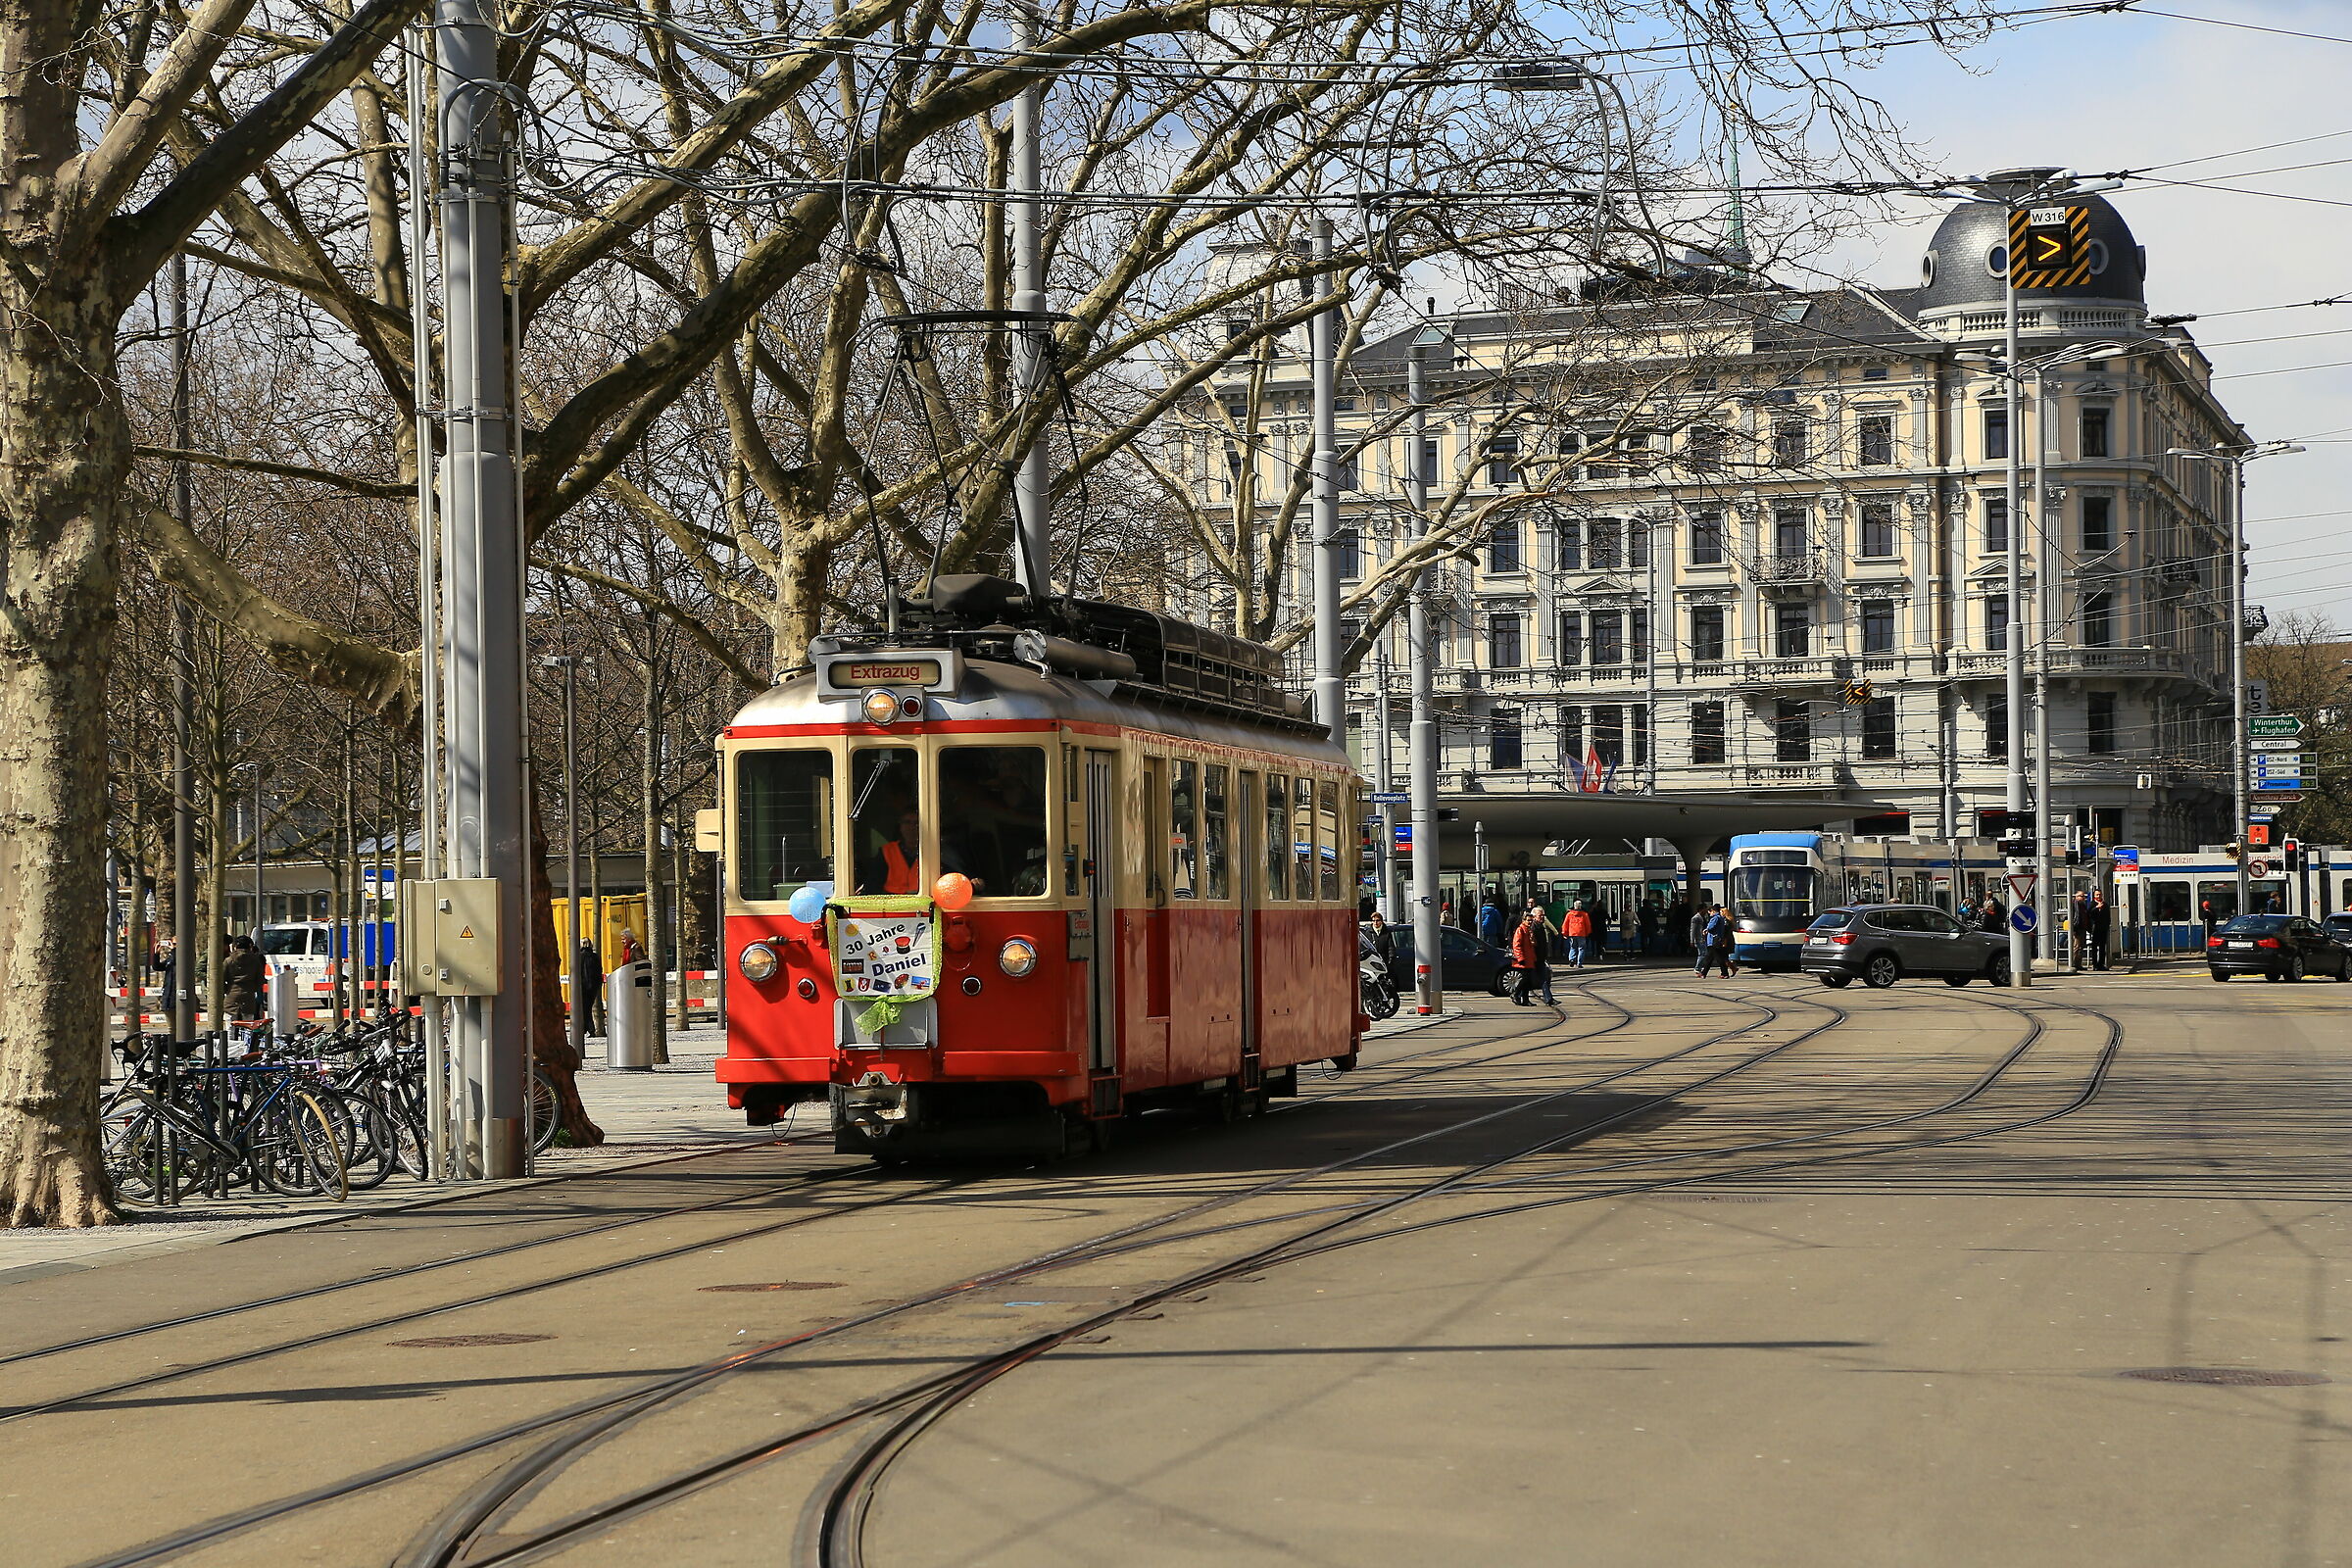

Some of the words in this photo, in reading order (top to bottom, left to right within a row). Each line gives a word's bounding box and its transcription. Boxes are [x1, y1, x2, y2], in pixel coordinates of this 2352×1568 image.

[2032, 213, 2042, 222] W
[2044, 212, 2065, 222] 316
[851, 664, 920, 681] Extrazug
[2261, 726, 2296, 736] Flughafen
[2162, 856, 2194, 864] Medizin
[845, 940, 863, 956] 30
[867, 923, 906, 947] Jahre
[871, 953, 927, 977] Daniel
